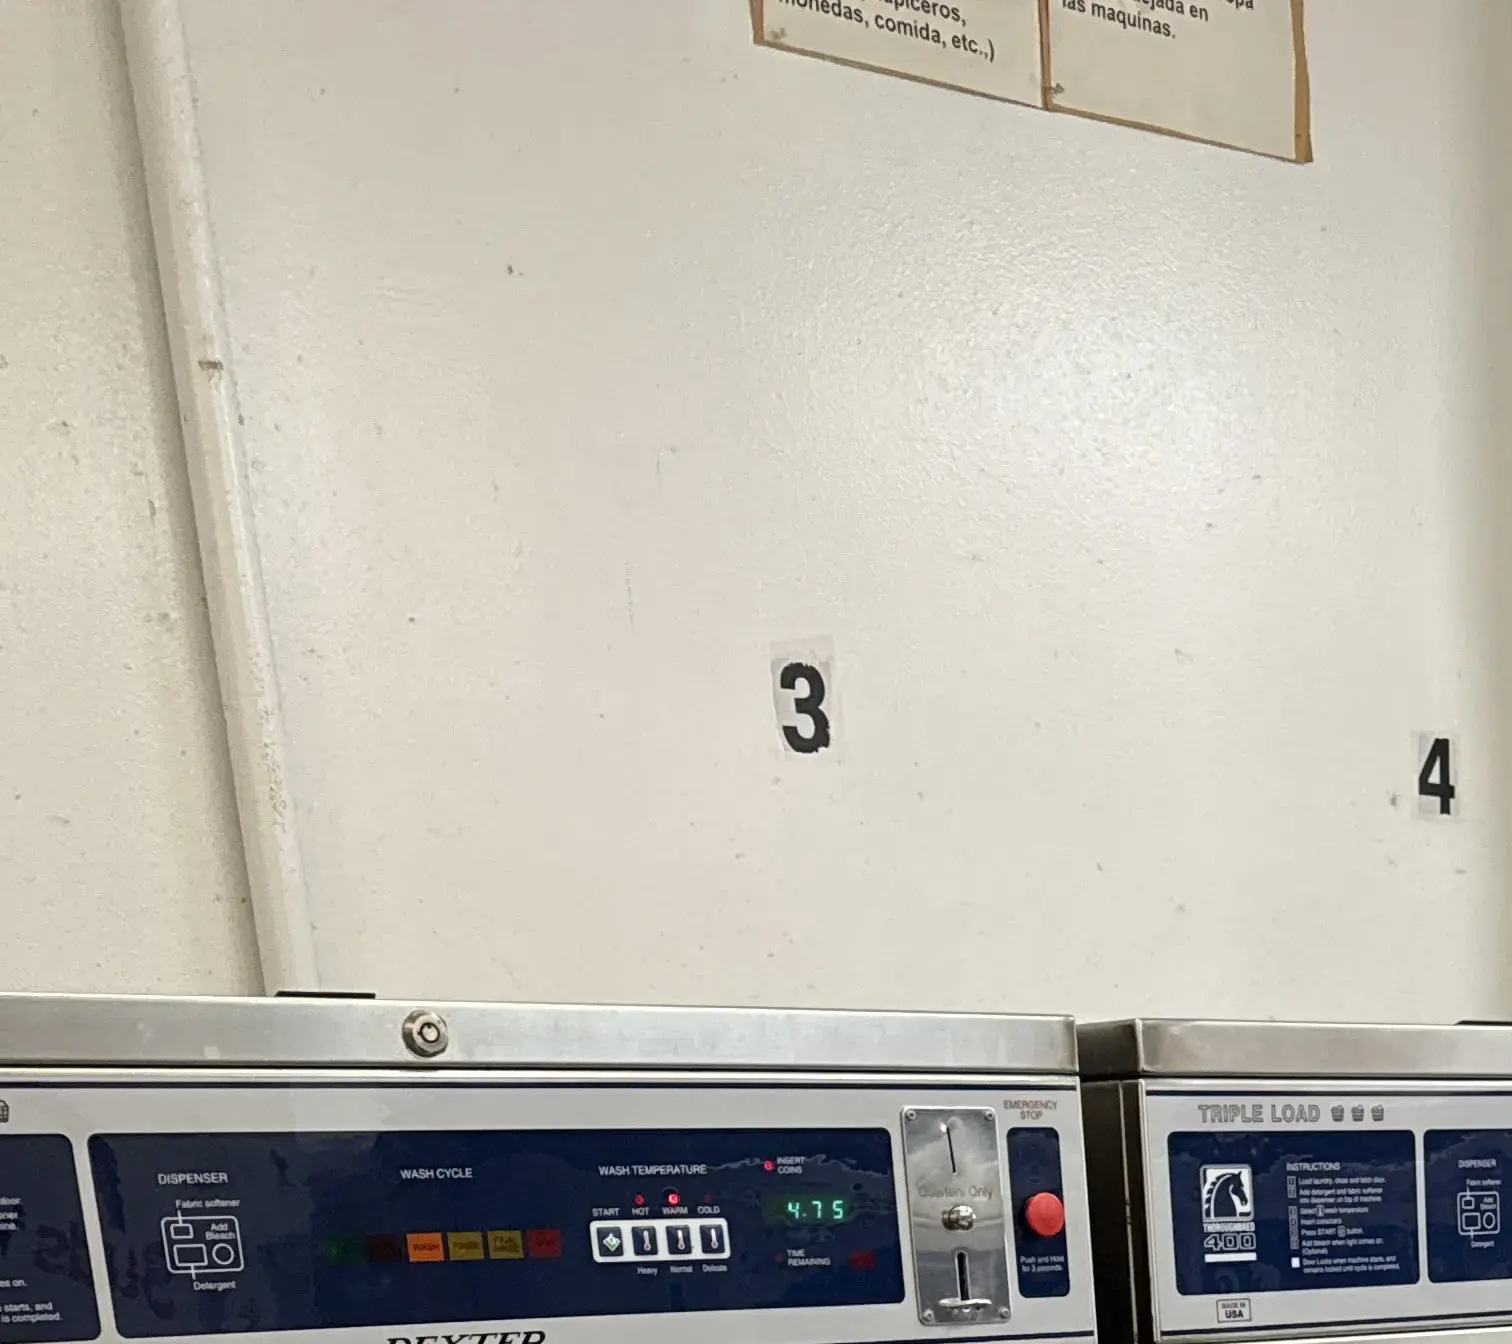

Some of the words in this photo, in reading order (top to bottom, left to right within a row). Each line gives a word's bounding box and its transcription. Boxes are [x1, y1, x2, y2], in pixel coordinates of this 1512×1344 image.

[1189, 5, 1208, 22] en
[1091, 2, 1176, 39] maquinas.
[875, 14, 947, 49] comida,
[780, 662, 830, 753] 3
[1418, 738, 1456, 815] 4
[1003, 1100, 1058, 1110] EMERGENCY
[1020, 1111, 1043, 1120] STOP
[1198, 1104, 1264, 1123] TRIPLE
[1270, 1104, 1321, 1123] LOAD
[776, 1156, 805, 1165] INSERT
[400, 1168, 434, 1180] WASH
[436, 1168, 473, 1179] CYCLE
[598, 1165, 630, 1176] WASH
[631, 1164, 708, 1175] TEMPERATURE
[777, 1166, 803, 1174] COINS
[157, 1172, 229, 1184] DISPENSER
[592, 1208, 620, 1217] START
[632, 1207, 650, 1216] HOT
[662, 1206, 688, 1215] WARM
[697, 1206, 720, 1215] COLD
[787, 1200, 844, 1219] 4.75
[211, 1223, 228, 1231] Add
[1203, 1232, 1256, 1251] 400
[787, 1249, 805, 1257] TIME
[788, 1257, 831, 1267] REMAINING
[1225, 1310, 1244, 1319] USA
